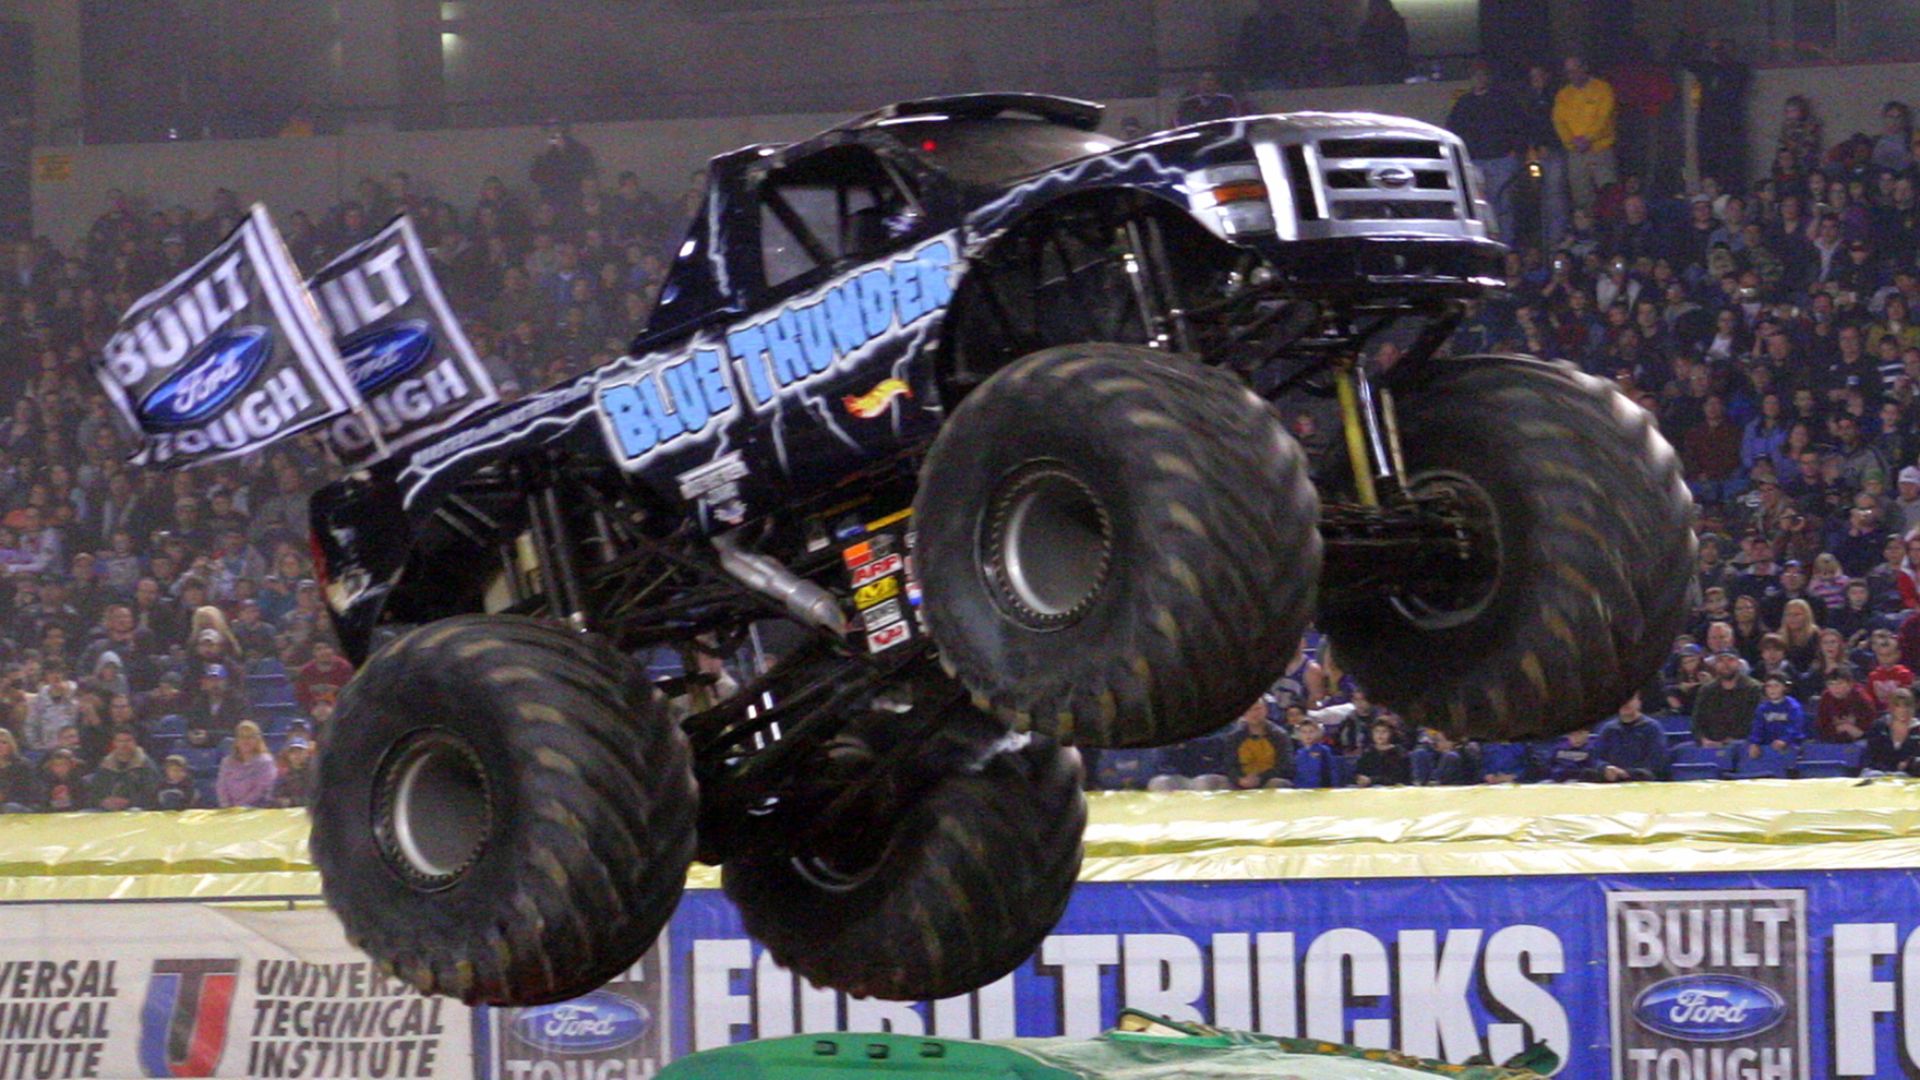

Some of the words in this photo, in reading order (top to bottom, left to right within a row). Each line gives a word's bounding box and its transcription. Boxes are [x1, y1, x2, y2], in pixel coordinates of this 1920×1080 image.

[103, 251, 249, 386] BUILT
[322, 243, 412, 336] ILT
[601, 349, 733, 459] BLUE
[727, 239, 953, 406] THUNDER
[172, 353, 242, 414] Ford
[1626, 908, 1789, 968] BUILT
[0, 1001, 109, 1039] NICAL
[252, 997, 444, 1037] TECHNICAL
[545, 1004, 616, 1037] Ford
[1043, 923, 1571, 1077] TRUCKS
[1669, 988, 1748, 1024] Ford
[247, 1039, 439, 1079] INSTITUTE
